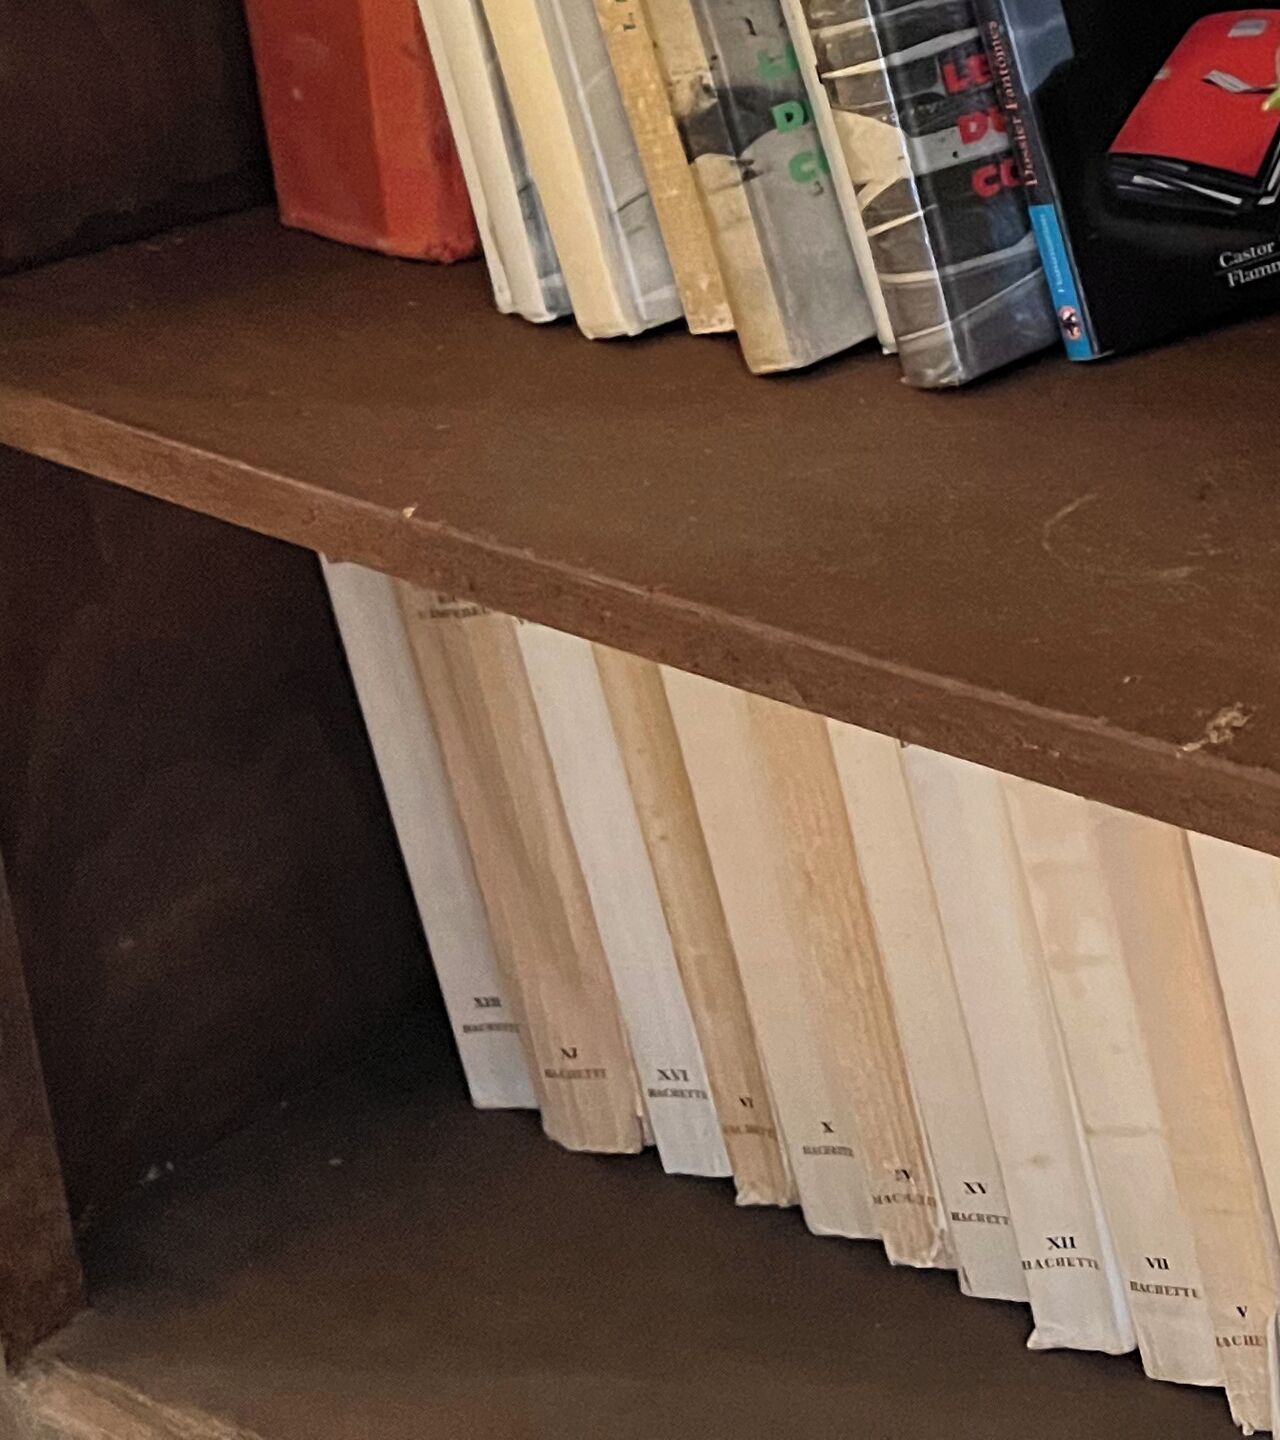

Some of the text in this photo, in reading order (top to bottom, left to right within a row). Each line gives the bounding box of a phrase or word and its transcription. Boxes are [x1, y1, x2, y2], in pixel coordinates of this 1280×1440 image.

[1220, 241, 1275, 268] Castor
[657, 1068, 689, 1082] XVI
[821, 1121, 834, 1133] X
[963, 1181, 988, 1195] XV
[1046, 1236, 1077, 1250] XII
[1021, 1257, 1101, 1271] HACHETTE
[1145, 1256, 1170, 1271] VII
[1130, 1280, 1201, 1299] HACHETTE
[1236, 1306, 1248, 1319] V
